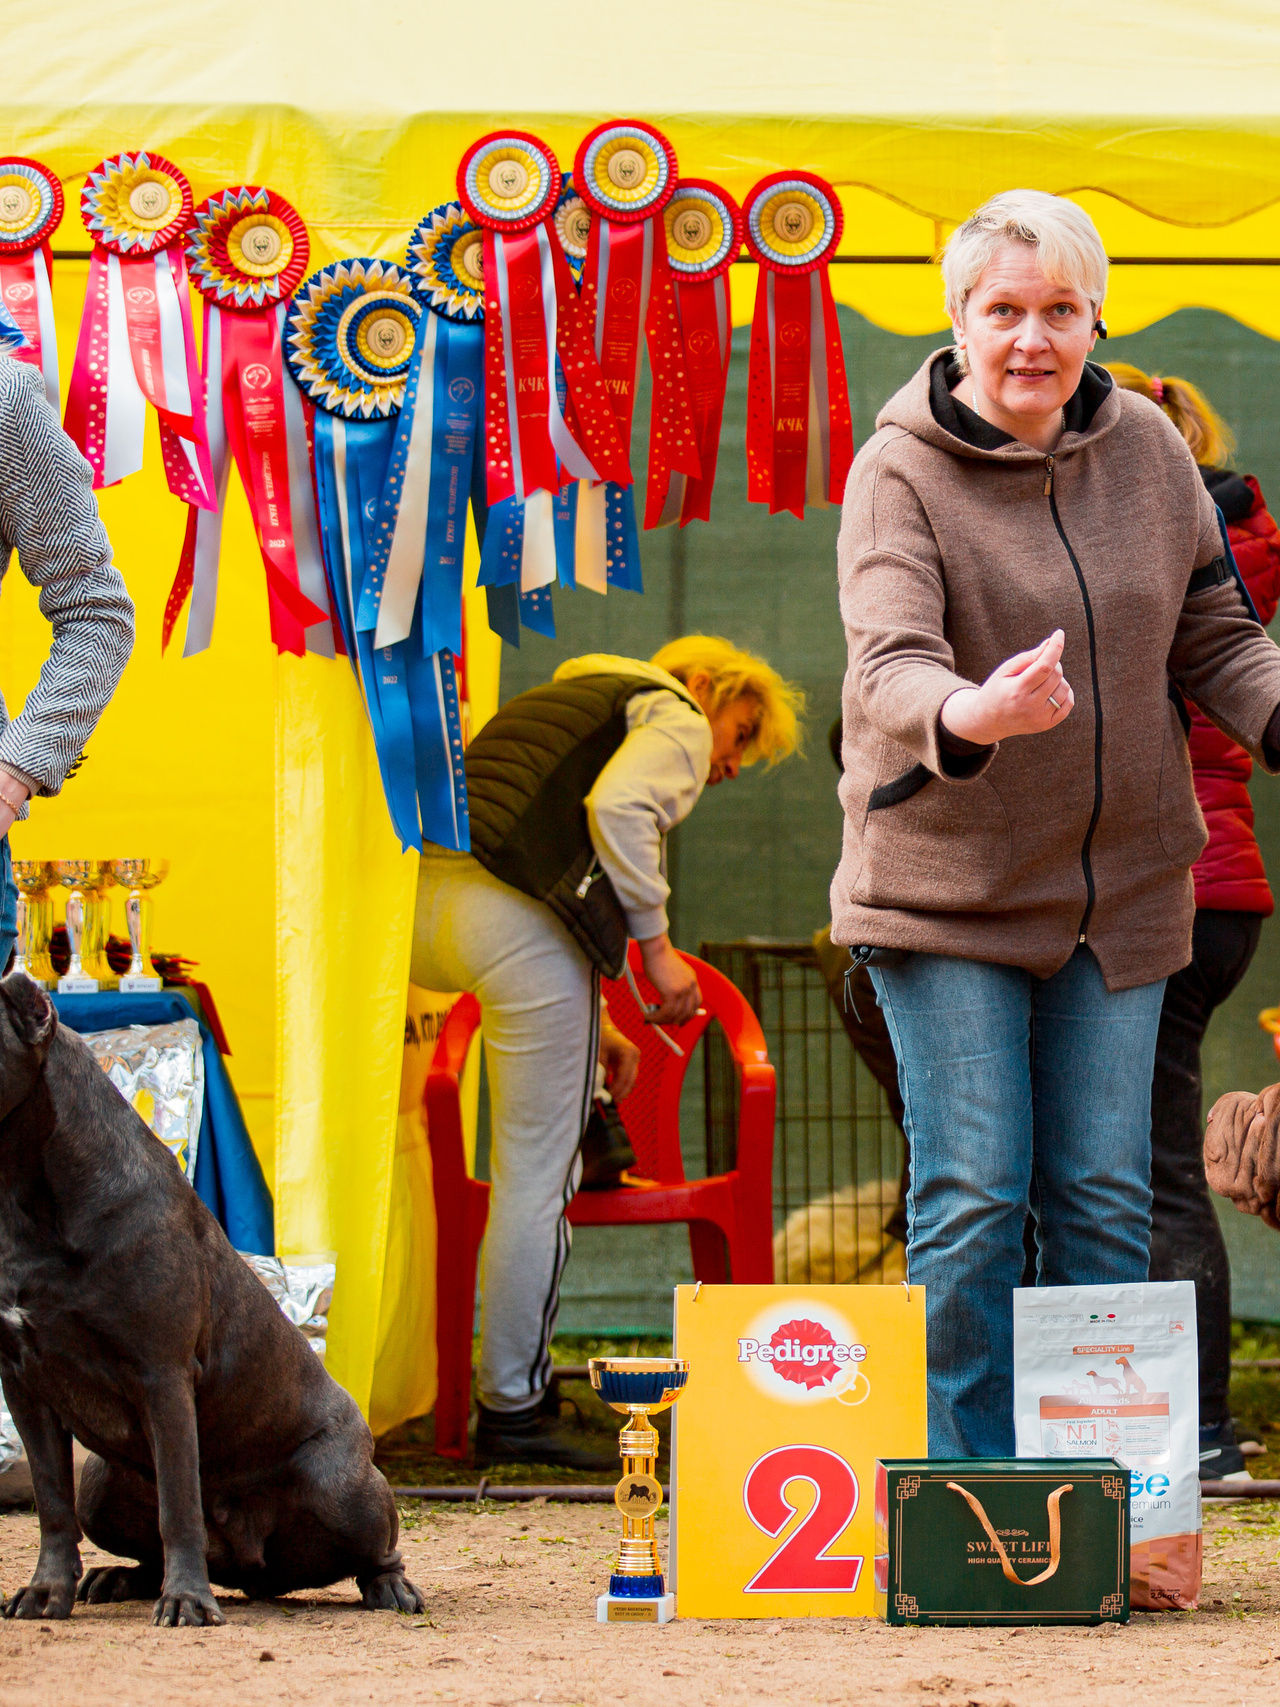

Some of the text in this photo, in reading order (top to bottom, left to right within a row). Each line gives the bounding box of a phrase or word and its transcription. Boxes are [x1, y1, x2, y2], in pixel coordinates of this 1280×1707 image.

[518, 376, 545, 393] КЧК
[776, 417, 805, 432] КЧК
[268, 539, 286, 548] 2022
[737, 1338, 867, 1366] Pedigree
[742, 1443, 865, 1593] 2
